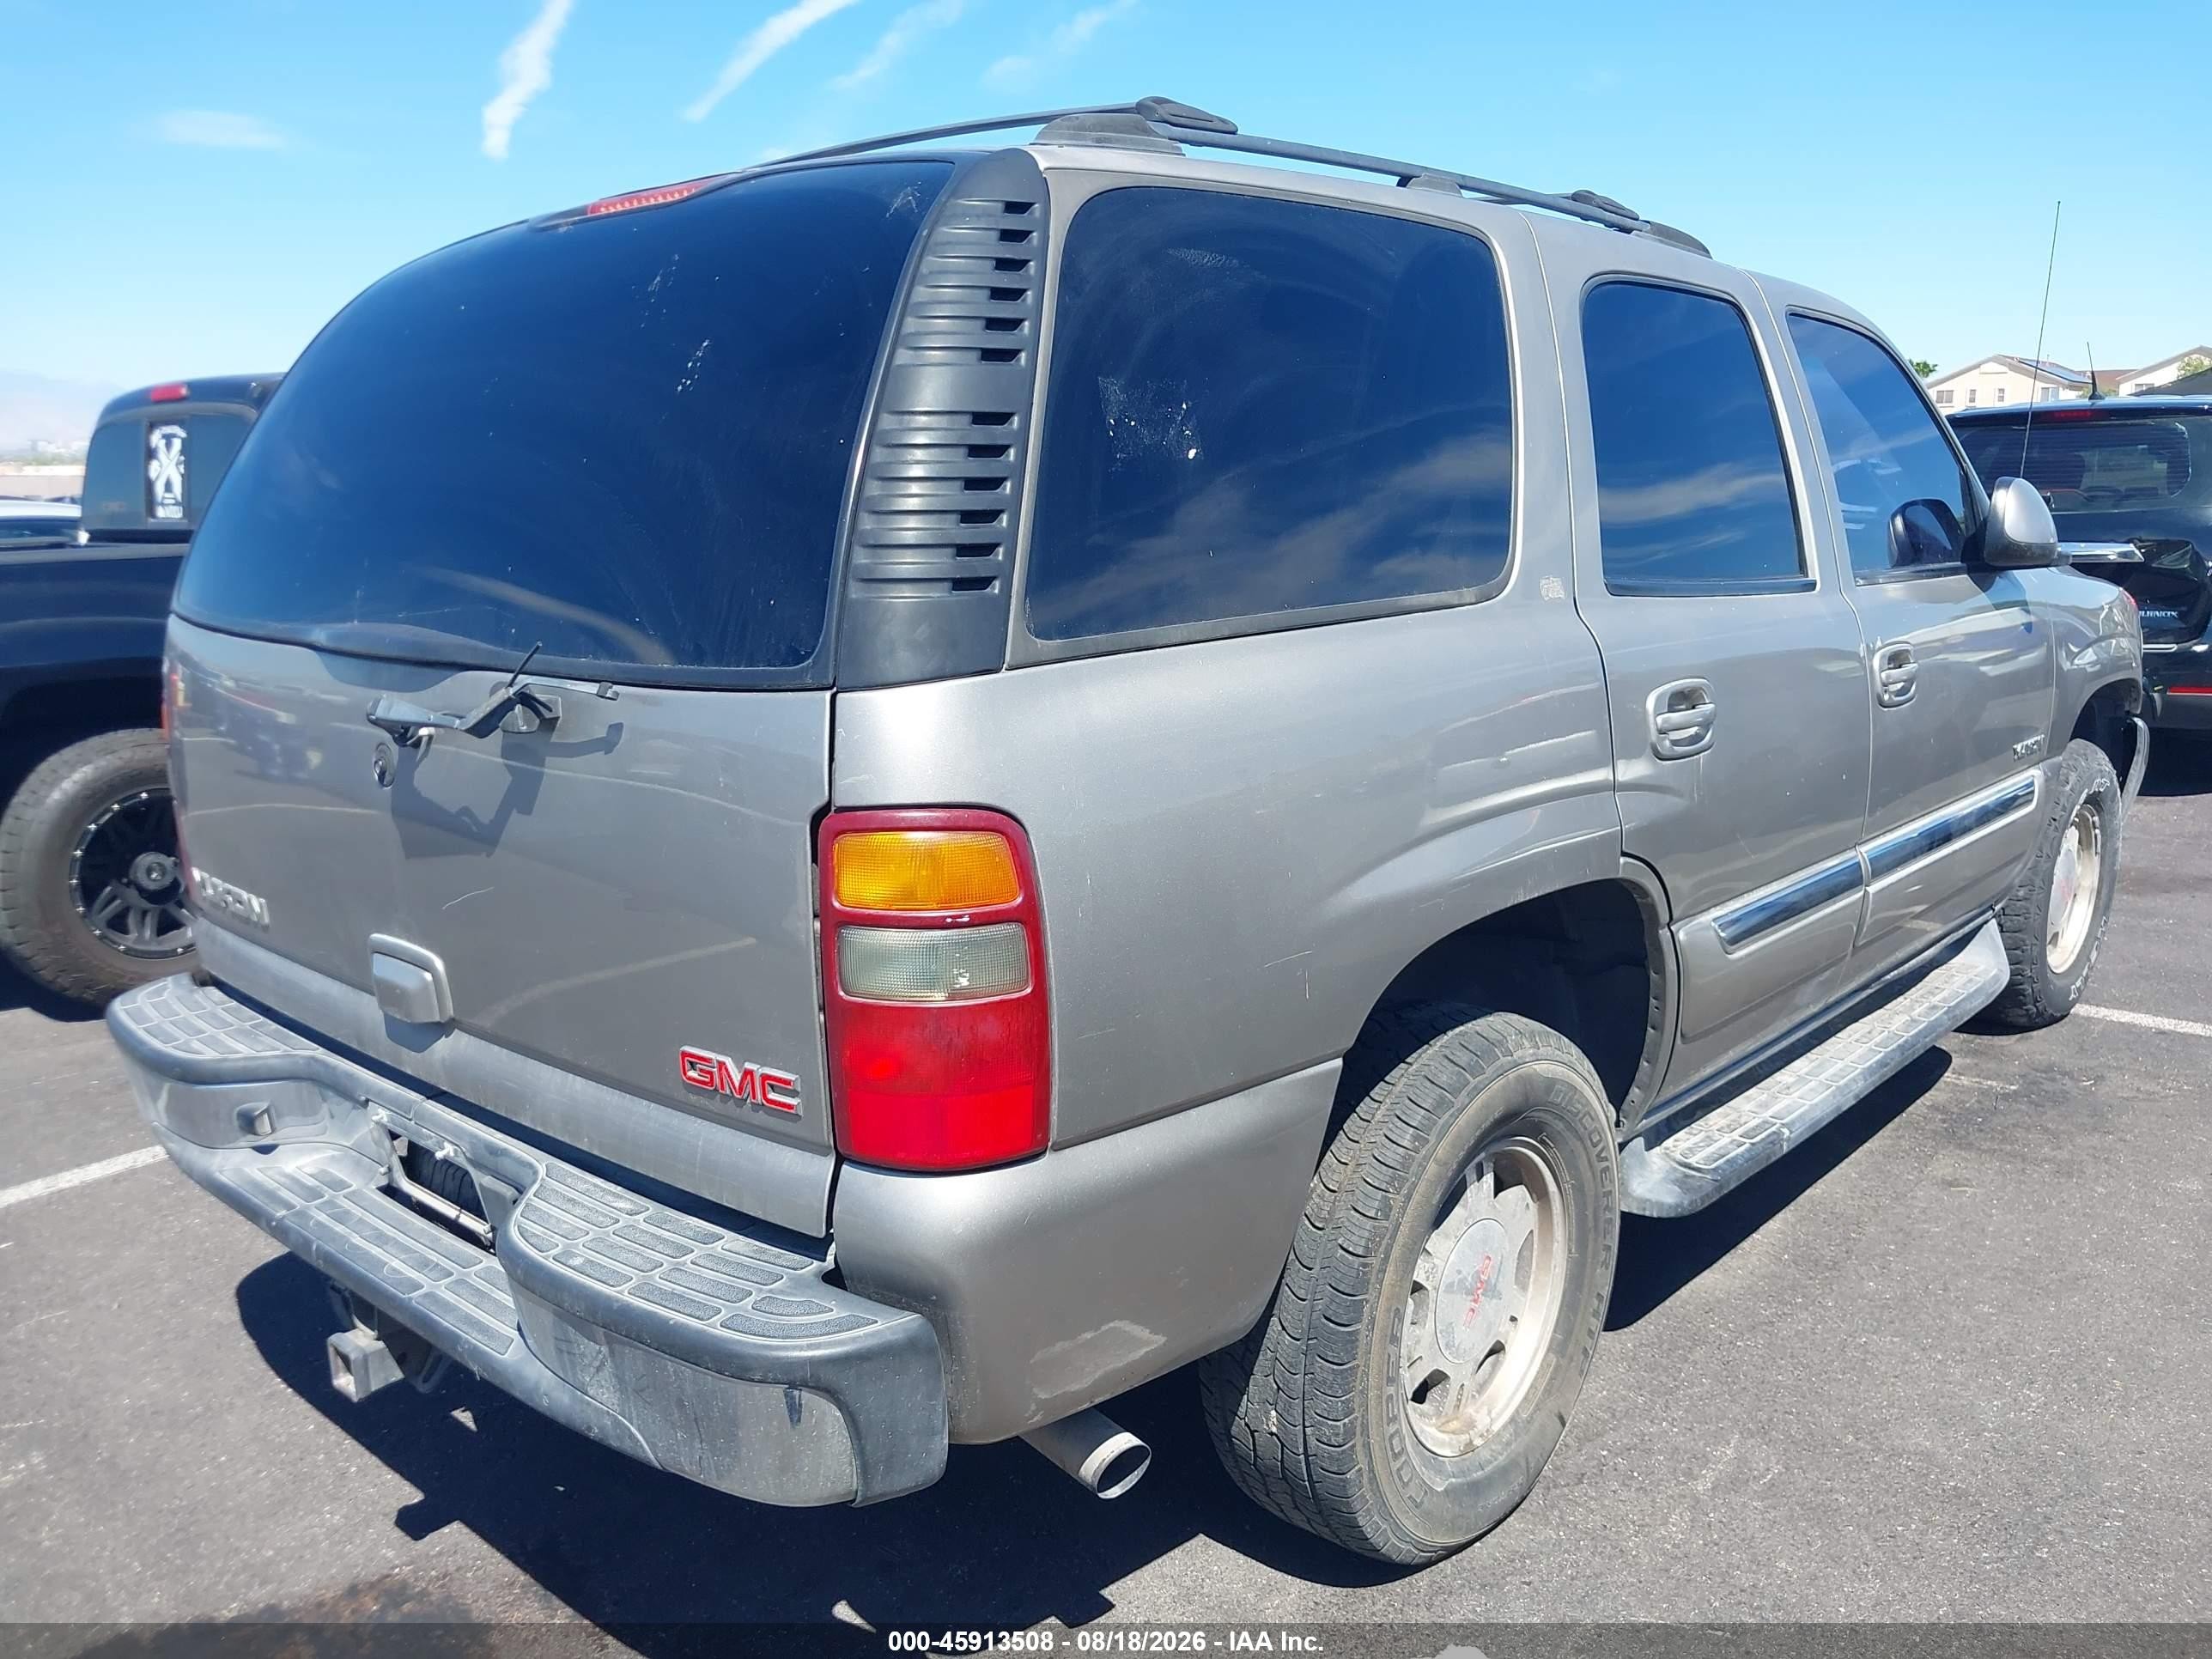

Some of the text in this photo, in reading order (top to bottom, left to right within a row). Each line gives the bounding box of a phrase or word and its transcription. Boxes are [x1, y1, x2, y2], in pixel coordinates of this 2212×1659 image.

[679, 1045, 803, 1116] GMC
[1548, 1084, 1613, 1271] DISCOVERER
[1462, 1255, 1492, 1330] GMC
[1385, 1306, 1429, 1509] COOPER
